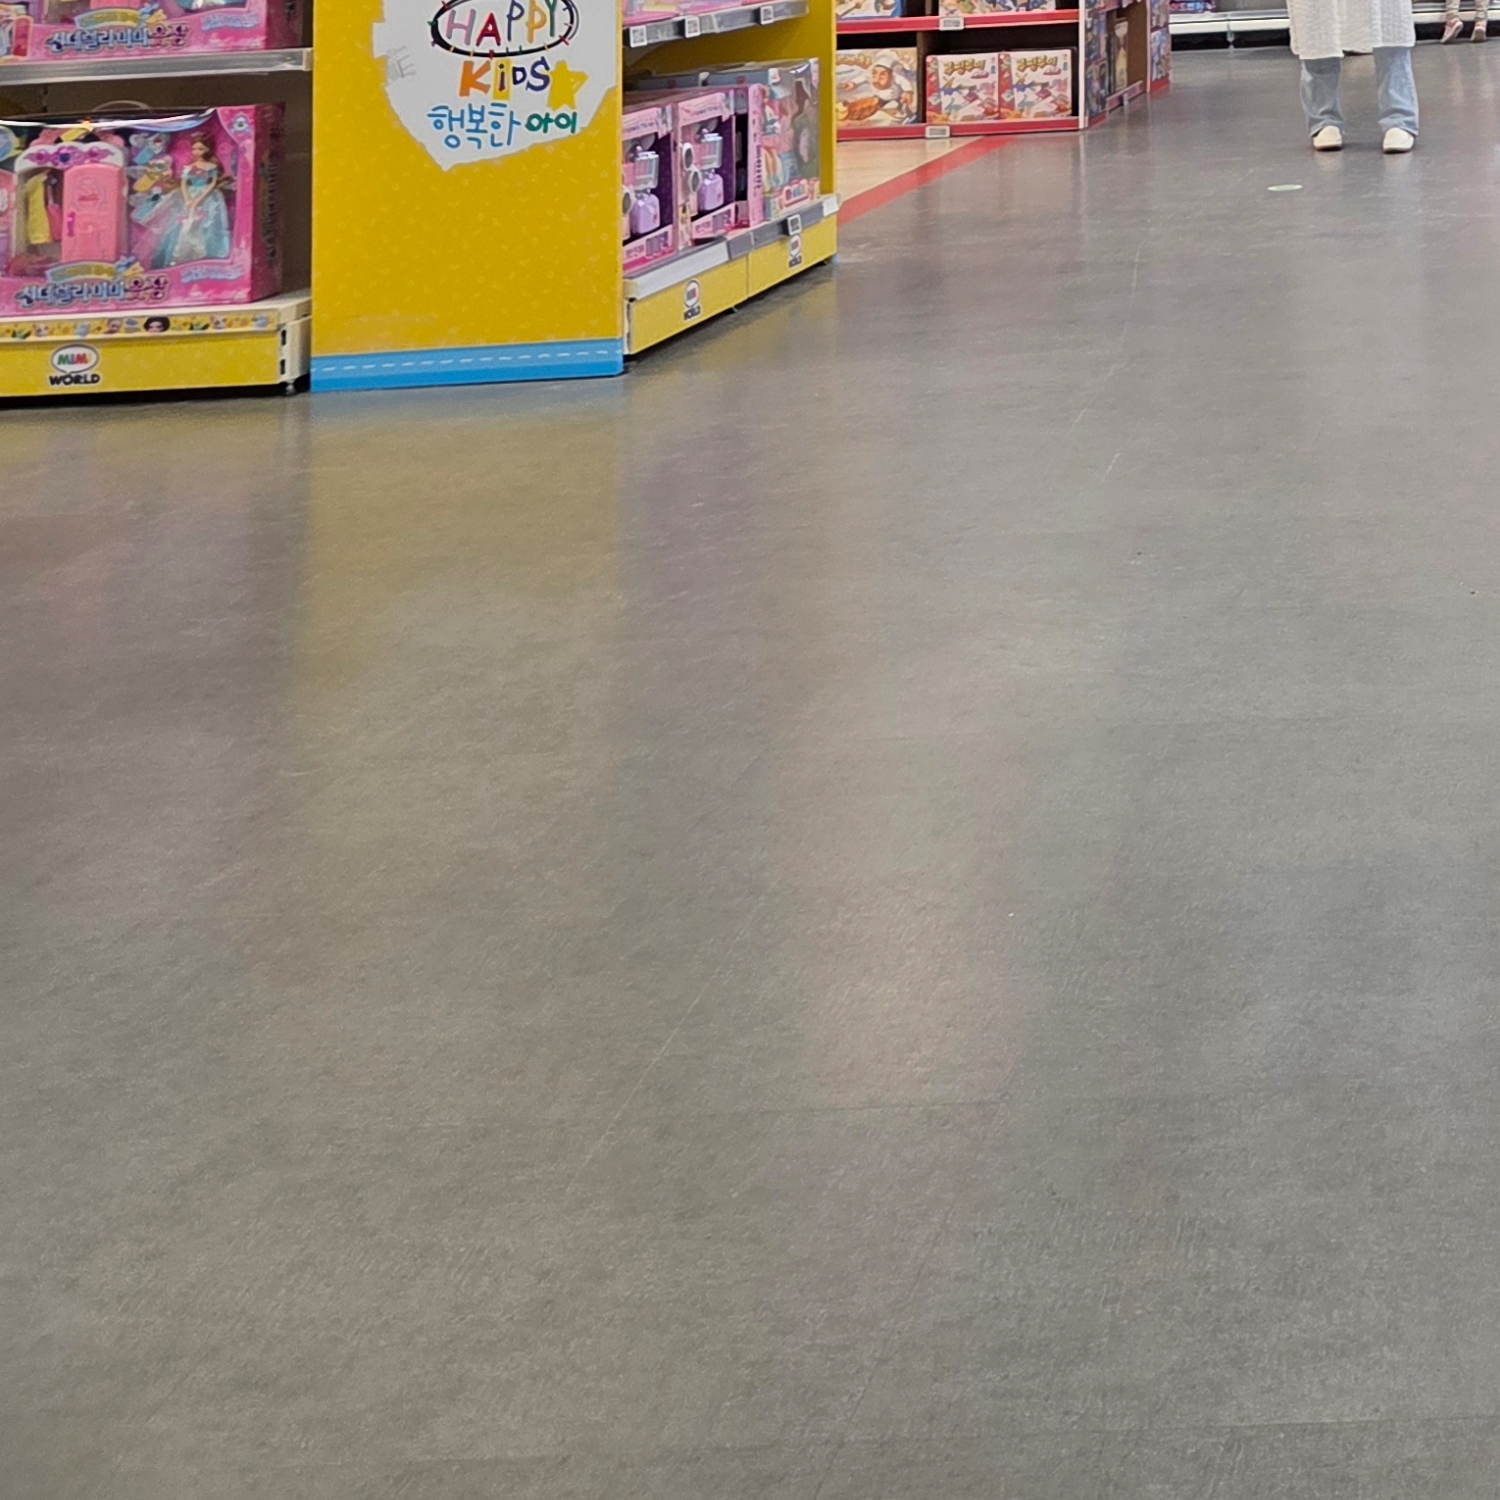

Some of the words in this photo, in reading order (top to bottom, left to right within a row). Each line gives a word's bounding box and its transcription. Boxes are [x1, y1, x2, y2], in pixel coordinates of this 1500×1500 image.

[427, 103, 521, 149] 행복한
[525, 111, 577, 134] 아이
[57, 352, 92, 367] MIMI
[49, 373, 100, 387] WORLD
